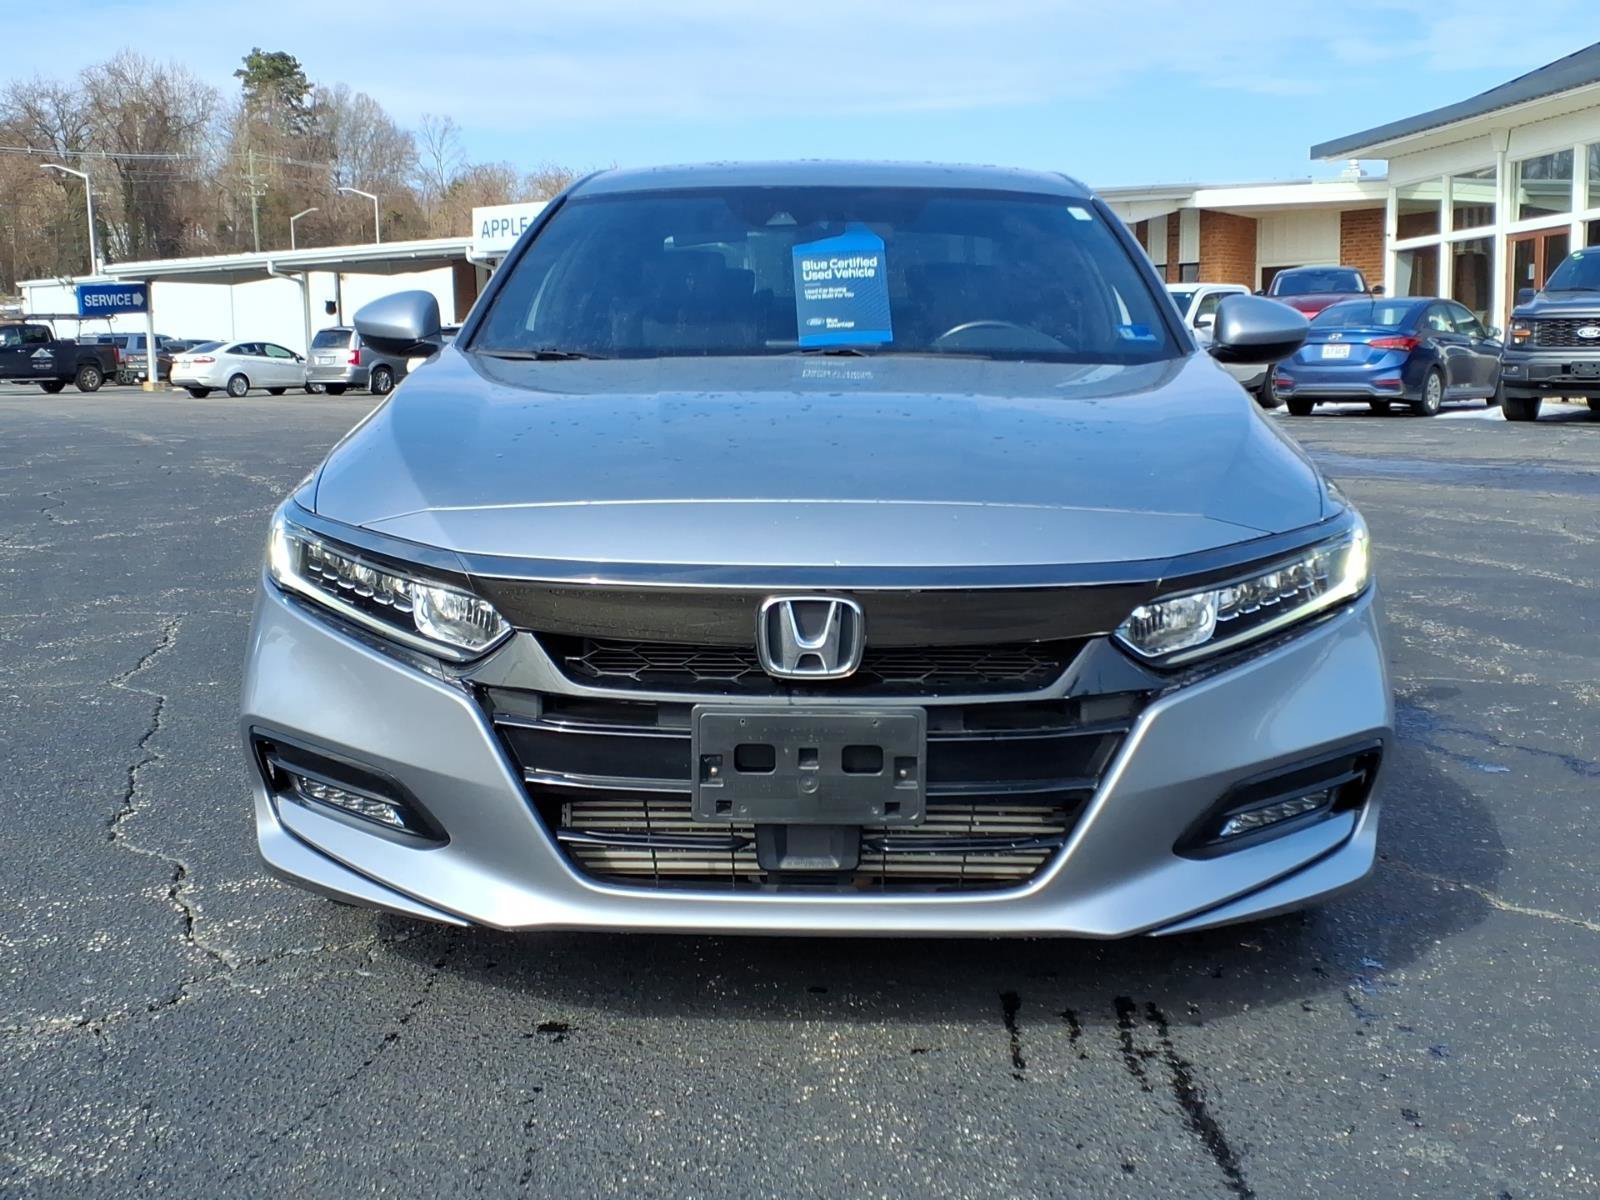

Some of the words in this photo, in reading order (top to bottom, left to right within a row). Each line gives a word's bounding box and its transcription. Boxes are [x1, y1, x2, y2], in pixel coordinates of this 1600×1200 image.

[481, 216, 528, 239] APPLE
[802, 260, 827, 271] Blue
[829, 256, 878, 269] Certified
[803, 269, 833, 281] Used
[834, 267, 875, 279] Vehicle
[84, 293, 132, 307] SERVICE
